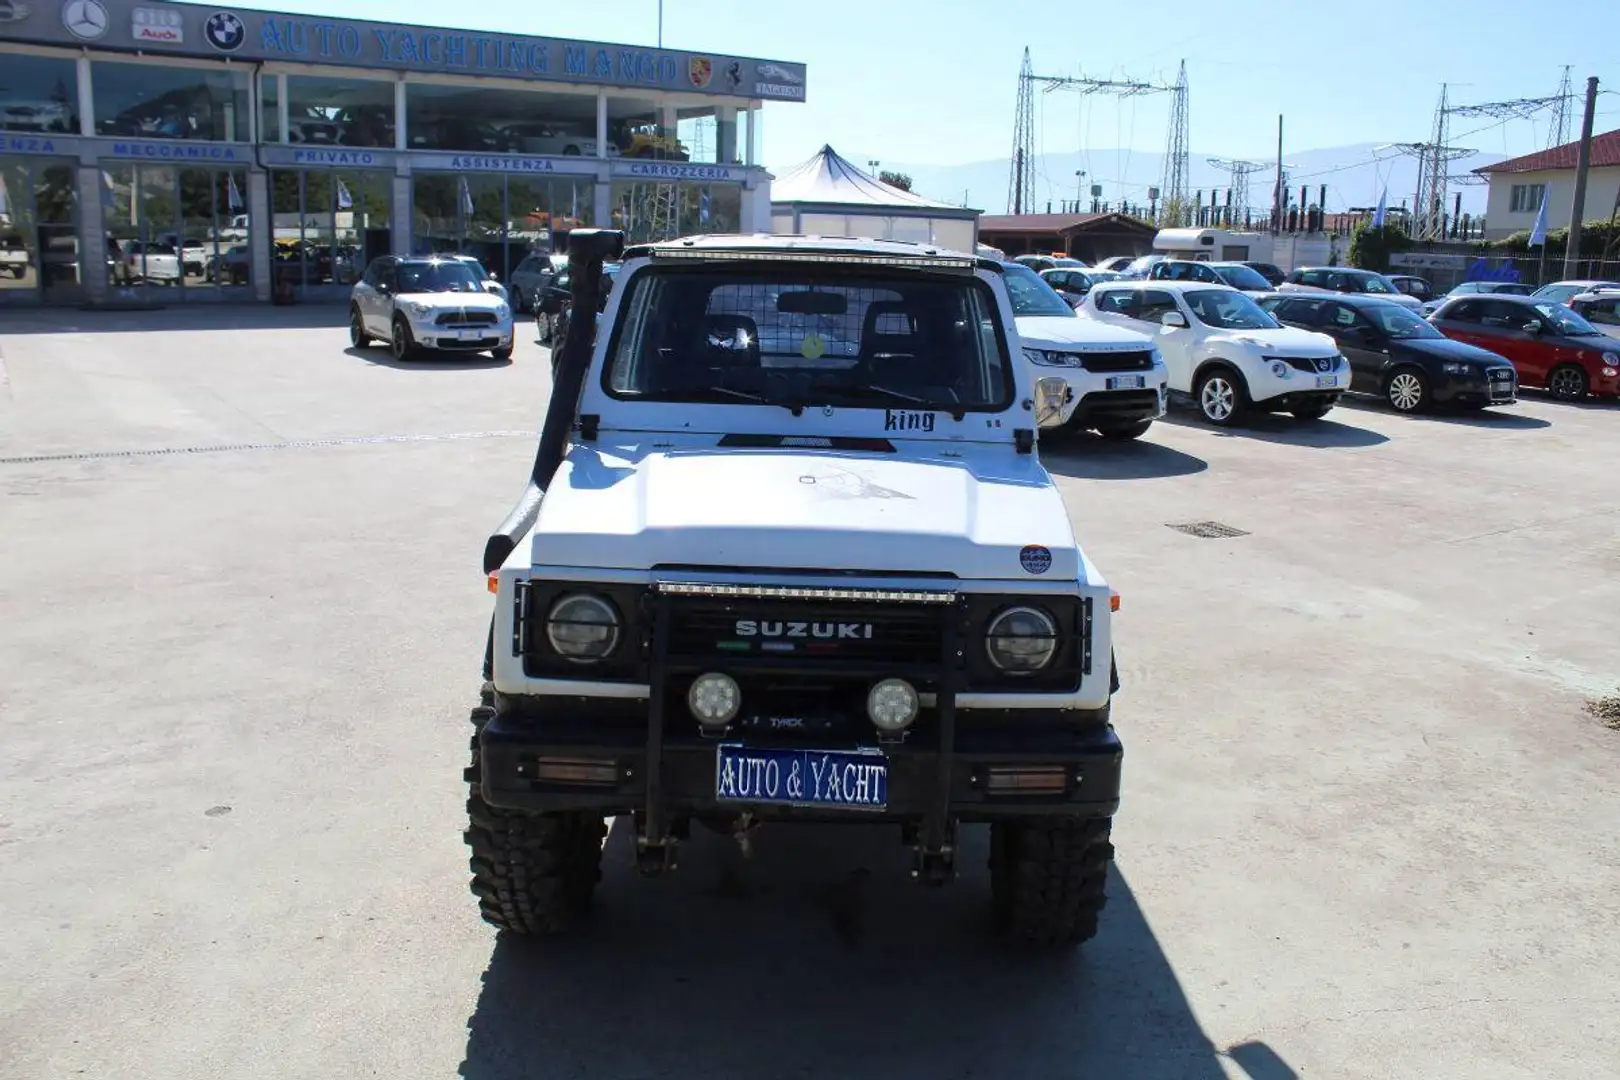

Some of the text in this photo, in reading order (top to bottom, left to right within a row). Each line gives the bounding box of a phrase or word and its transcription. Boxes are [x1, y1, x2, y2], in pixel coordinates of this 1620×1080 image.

[260, 17, 677, 83] AUTO YACHTING MANGO
[113, 143, 235, 160] MECCANICA
[294, 150, 373, 164] PRIVATO
[451, 156, 554, 171] ASSISTENZA
[631, 163, 730, 179] CARROZZERIA
[884, 409, 935, 432] king
[735, 620, 873, 639] SUZUKI
[719, 755, 887, 804] AUTO & YACHT
